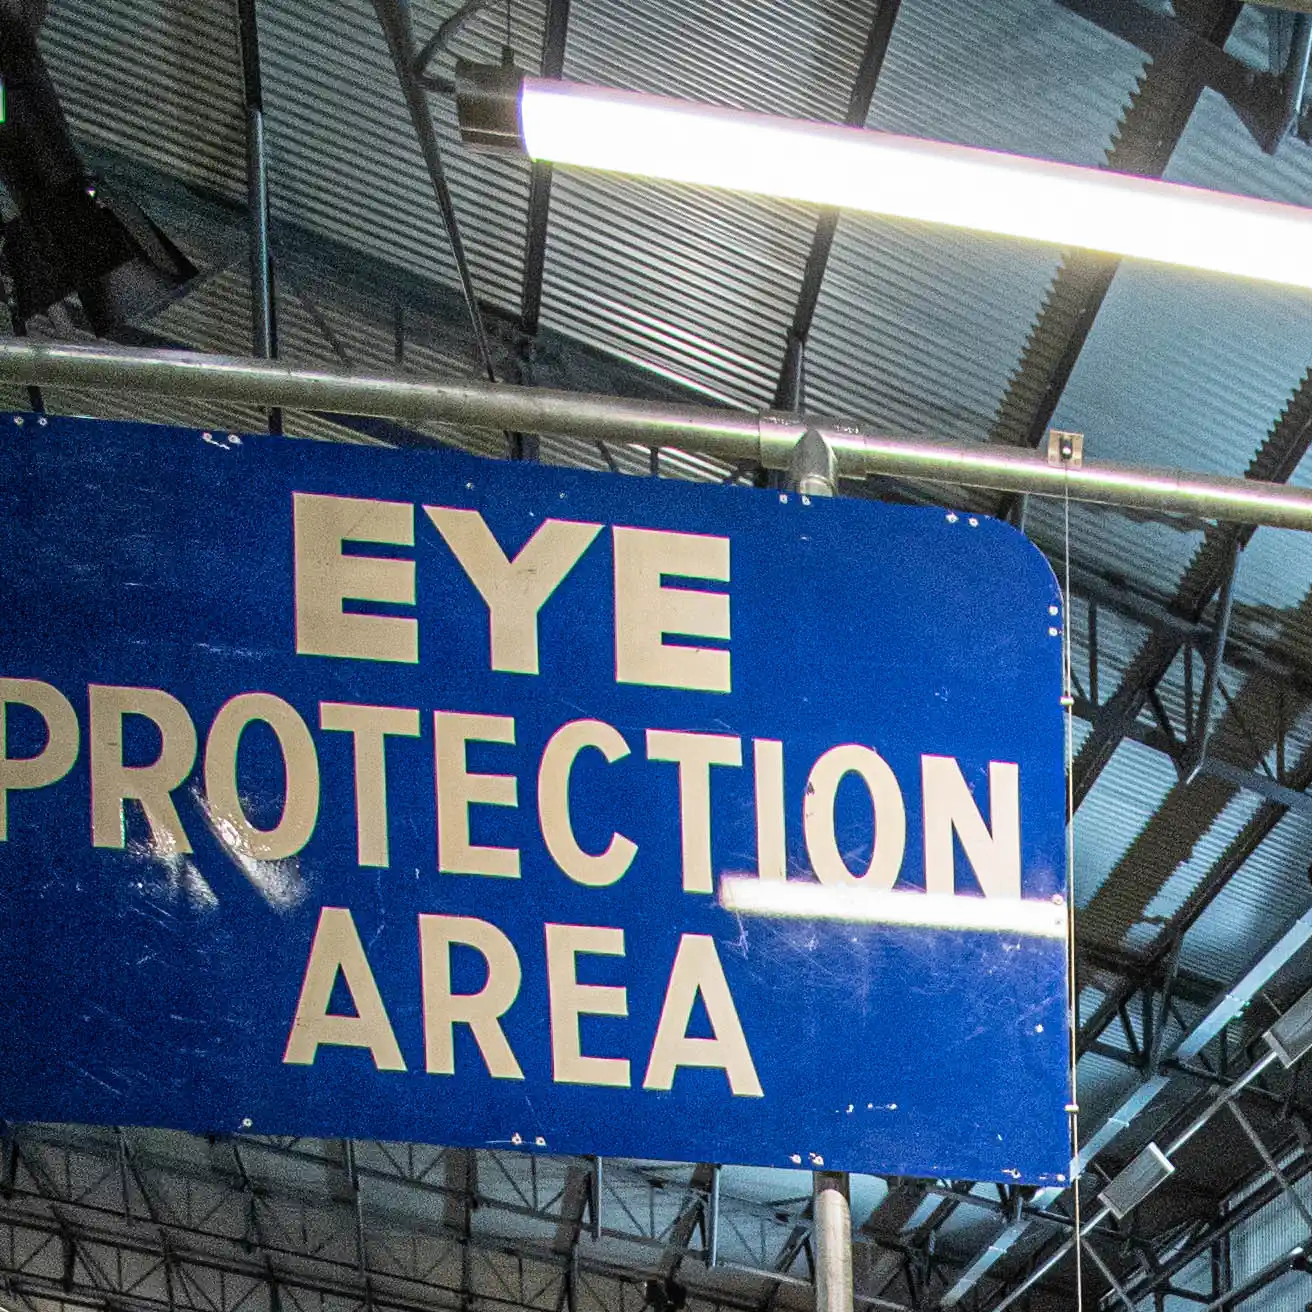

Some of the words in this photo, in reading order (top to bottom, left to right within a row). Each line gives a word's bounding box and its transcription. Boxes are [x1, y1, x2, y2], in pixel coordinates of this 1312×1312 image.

[292, 491, 731, 693] EYE
[0, 677, 1021, 898] PROTECTION
[282, 907, 764, 1097] AREA
